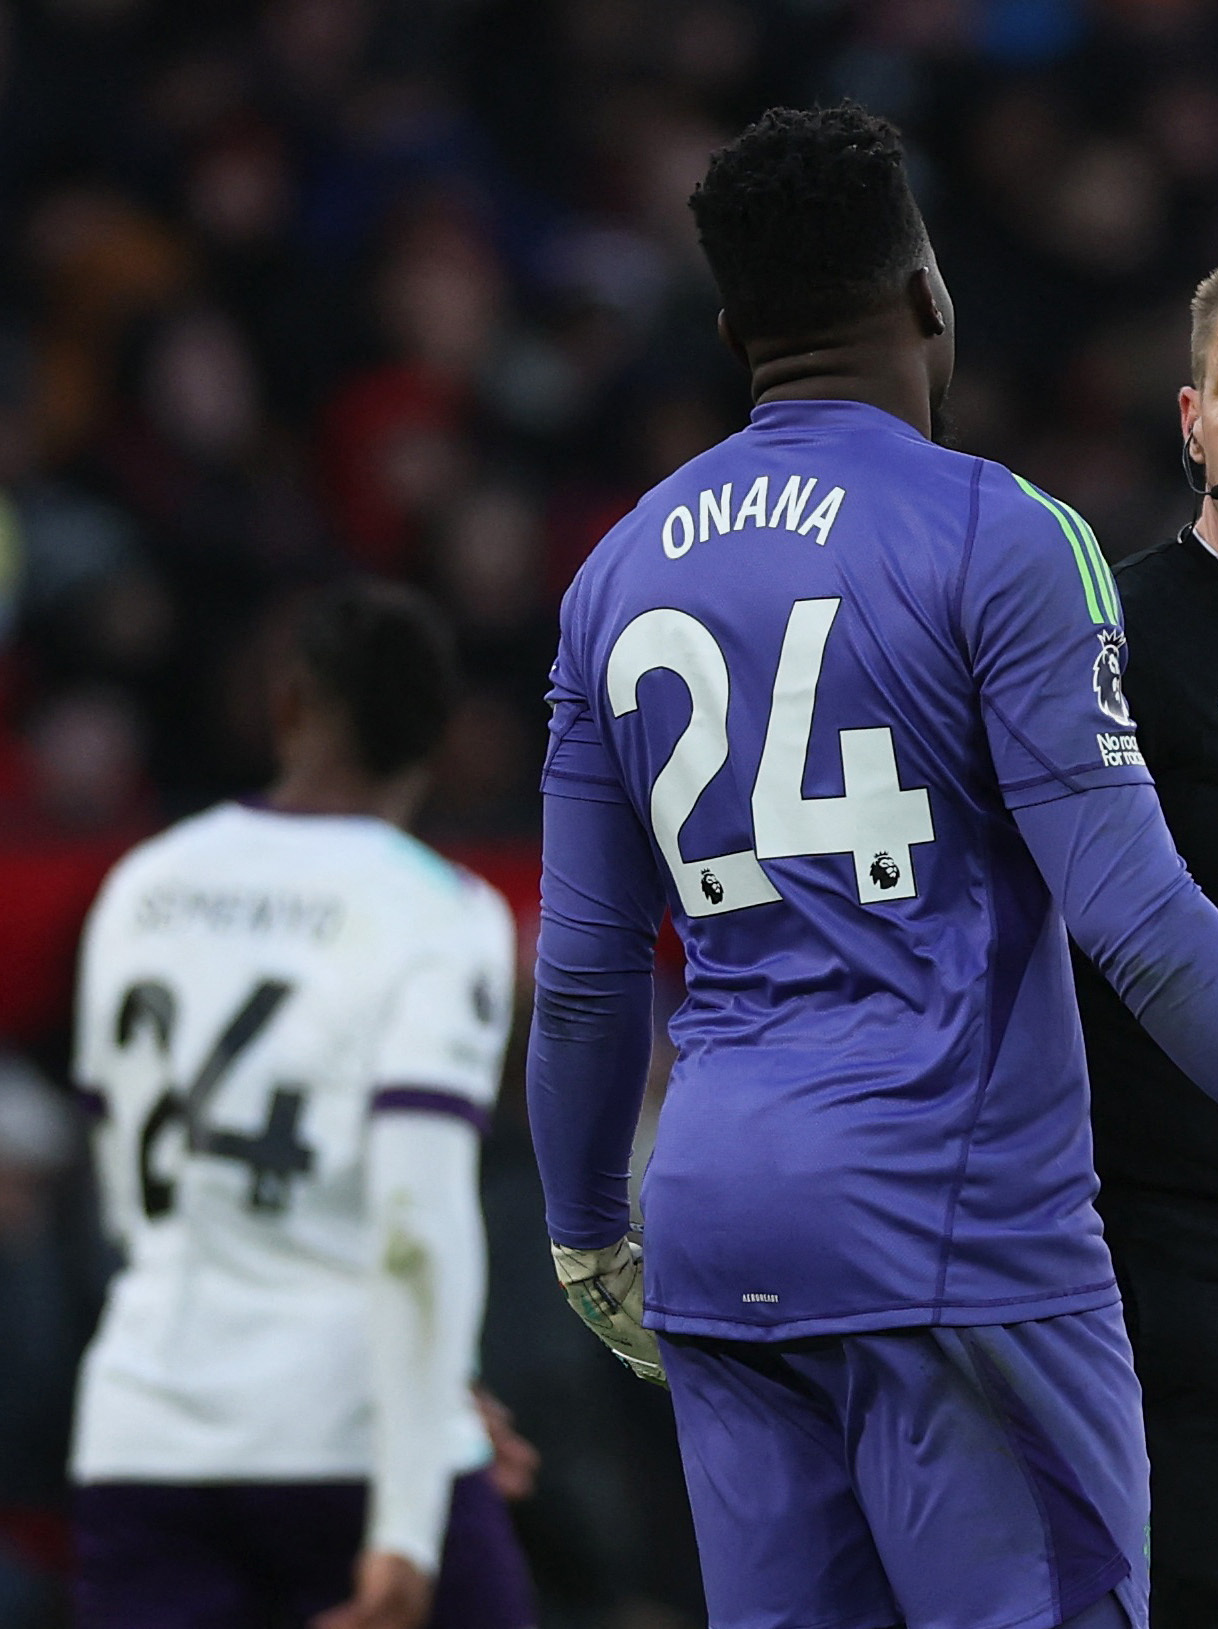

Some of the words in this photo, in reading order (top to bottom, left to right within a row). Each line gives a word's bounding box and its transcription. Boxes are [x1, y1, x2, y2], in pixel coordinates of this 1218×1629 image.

[661, 475, 846, 560] ONANA
[607, 597, 935, 919] 24
[1096, 732, 1120, 751] No
[1102, 749, 1123, 767] For
[114, 973, 316, 1220] 24
